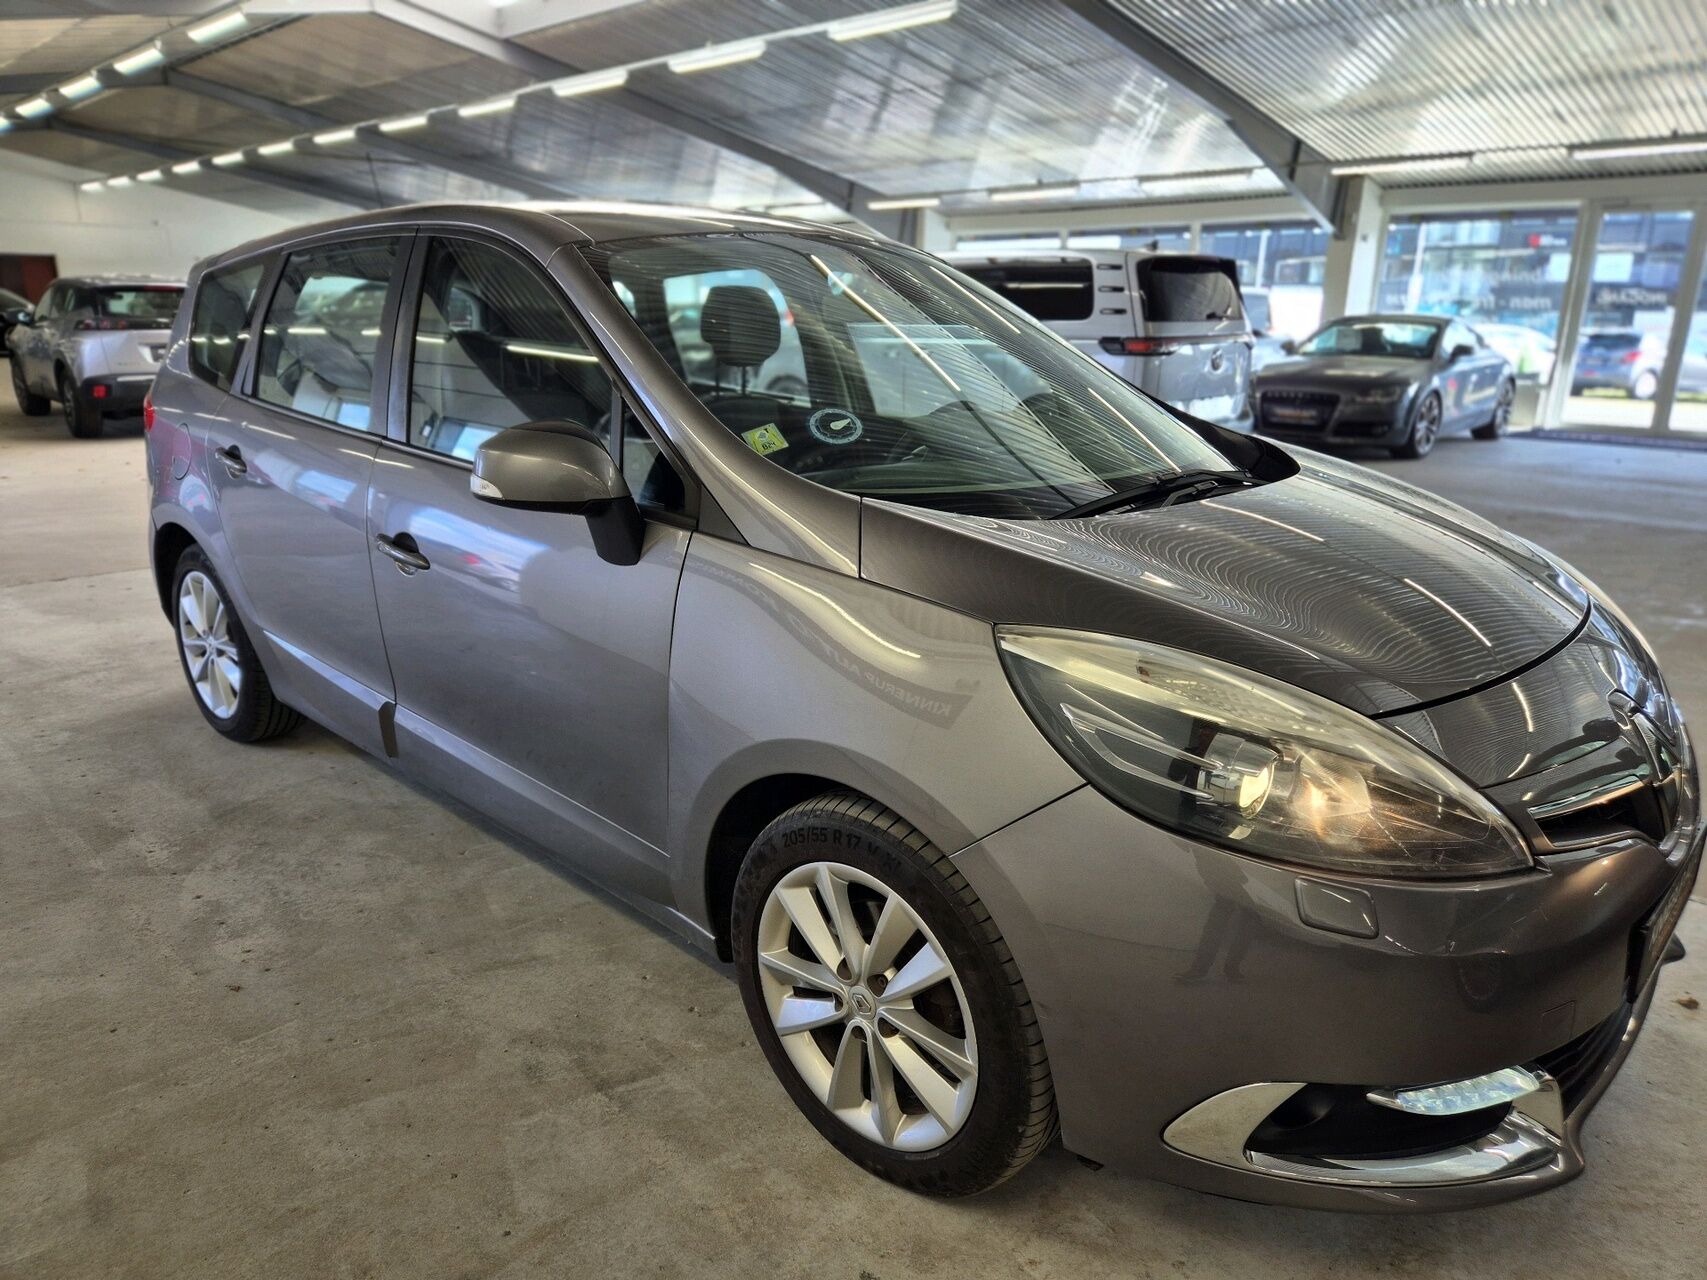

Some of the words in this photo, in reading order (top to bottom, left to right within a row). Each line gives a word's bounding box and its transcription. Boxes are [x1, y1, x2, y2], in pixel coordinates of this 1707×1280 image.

[782, 827, 828, 848] 205/55
[832, 829, 842, 845] R
[845, 832, 862, 851] 17
